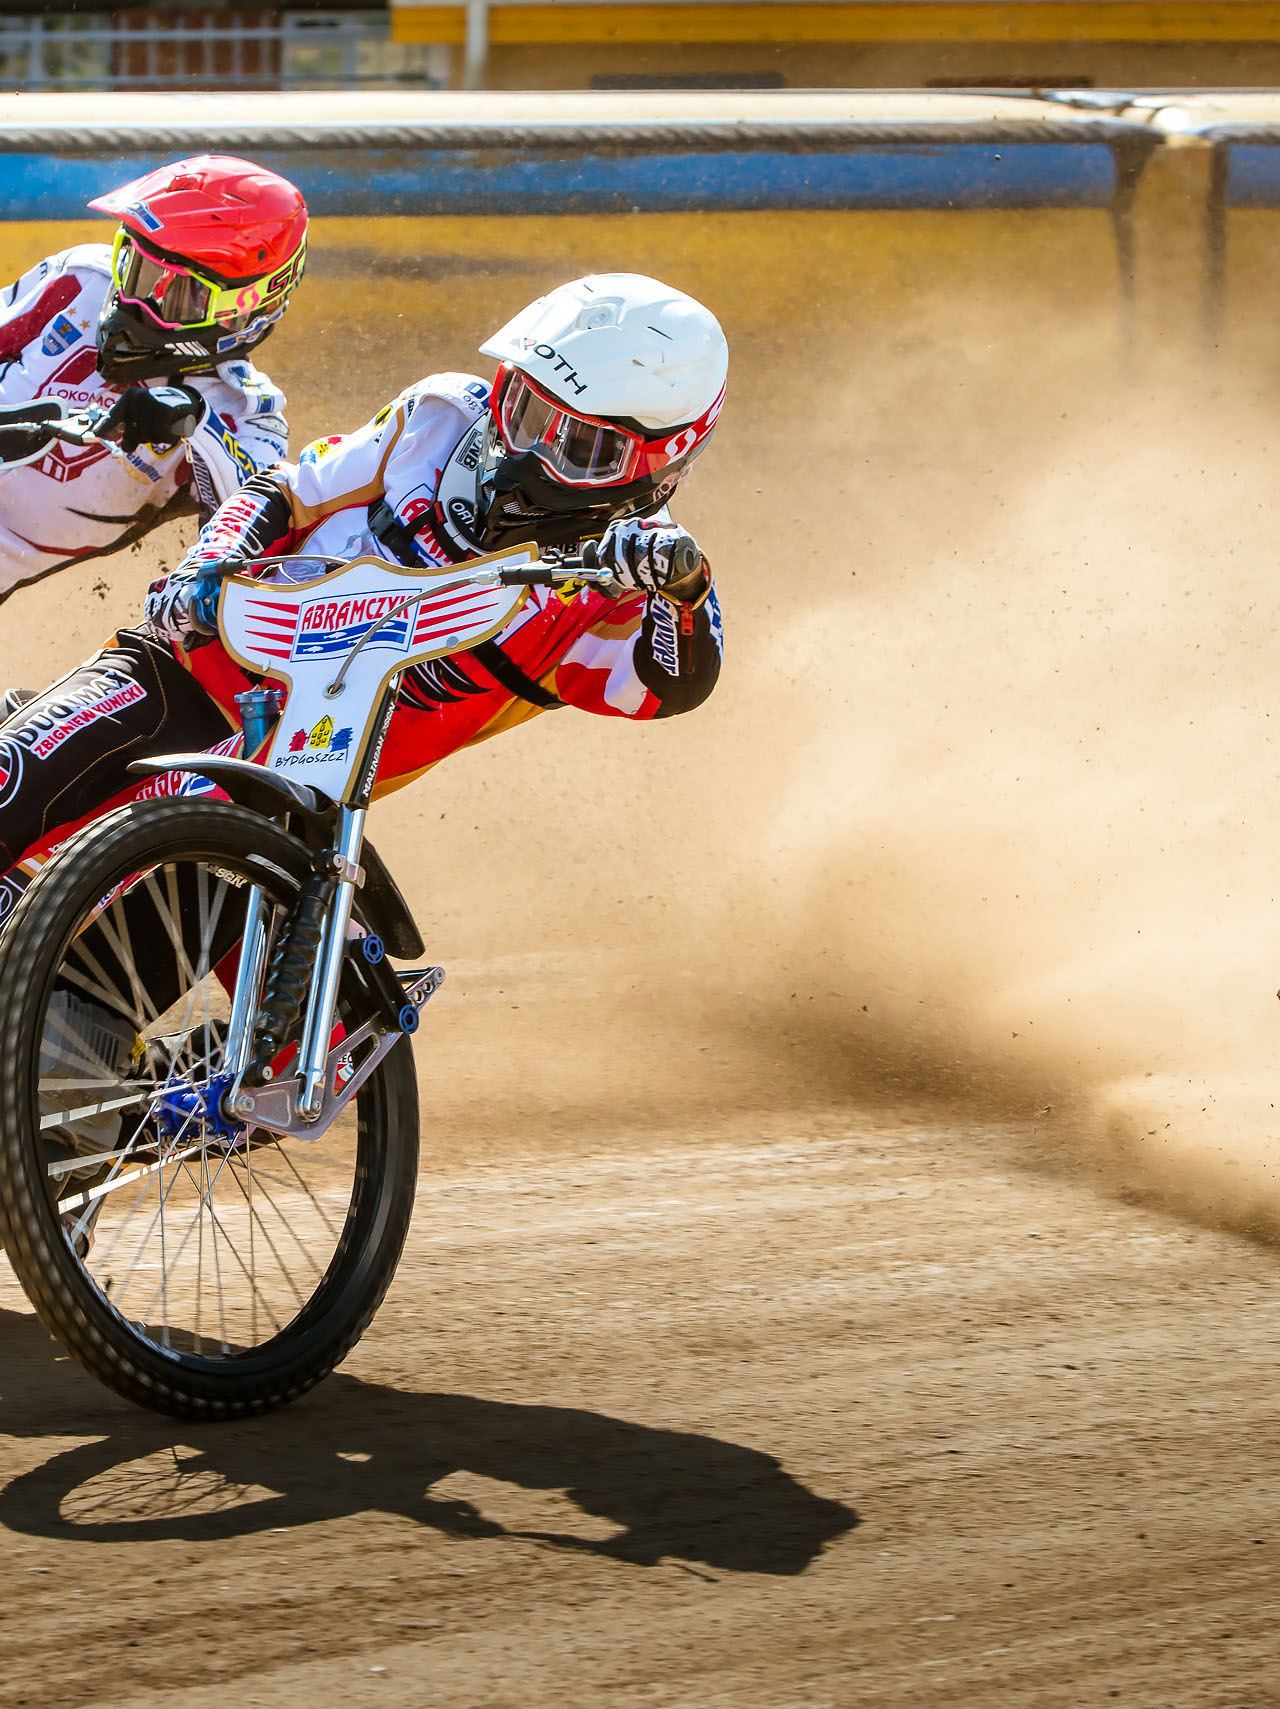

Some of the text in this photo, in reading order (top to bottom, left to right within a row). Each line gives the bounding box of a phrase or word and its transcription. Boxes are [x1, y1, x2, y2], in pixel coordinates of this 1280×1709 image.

[301, 594, 414, 632] ABRAMCZYK
[34, 708, 97, 758] ZBIGNIEW
[275, 751, 348, 768] BYDGOSZCZ
